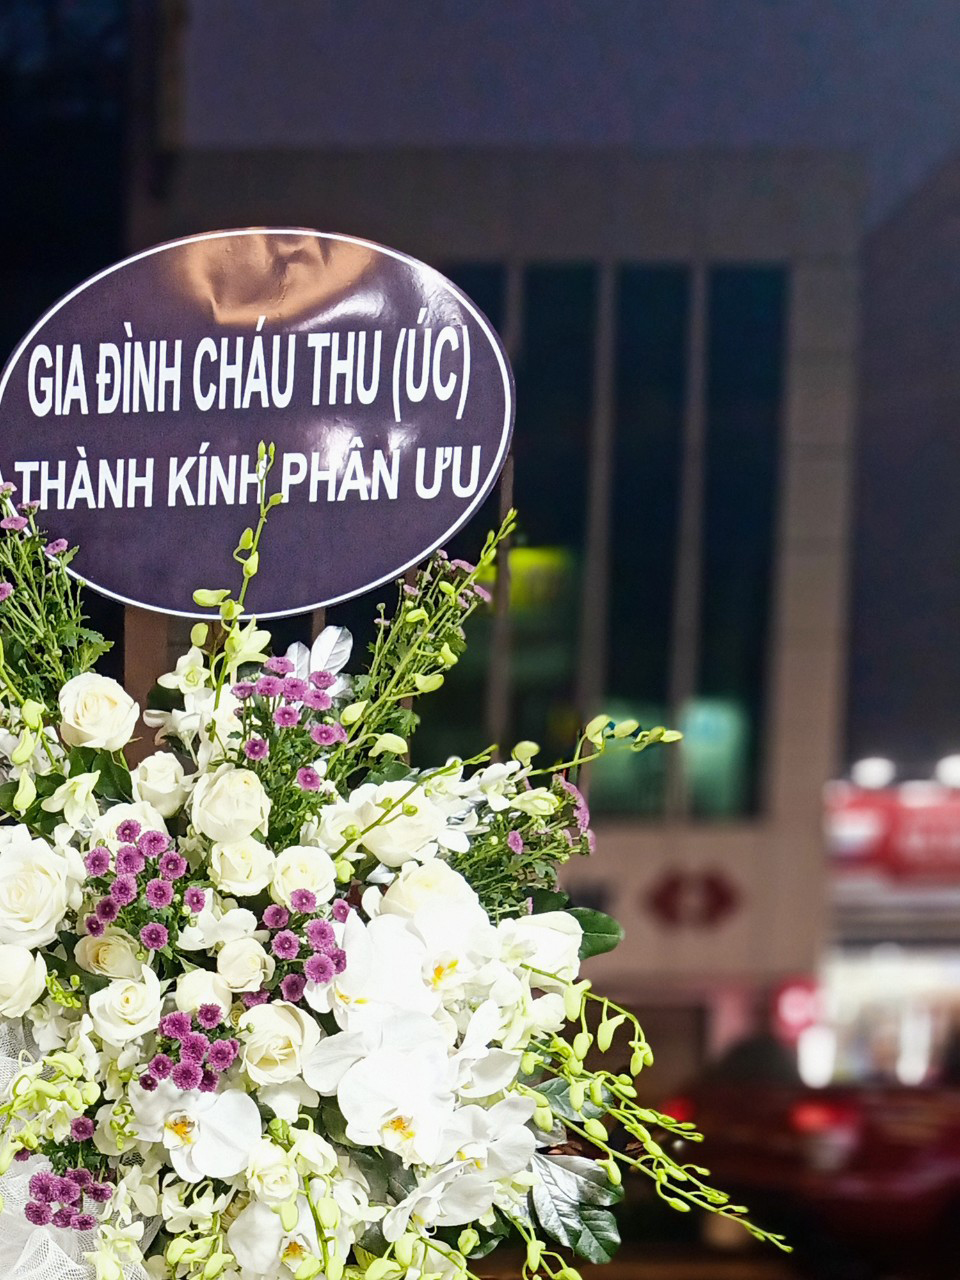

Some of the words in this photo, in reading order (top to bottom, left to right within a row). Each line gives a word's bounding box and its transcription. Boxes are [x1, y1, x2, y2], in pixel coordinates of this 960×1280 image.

[27, 343, 89, 417] GIA
[95, 321, 183, 414] ĐÌNH
[193, 315, 296, 411] CHÁU
[307, 330, 382, 405] THU
[392, 307, 471, 422] (ÚC)
[14, 446, 154, 510] THÀNH
[167, 442, 267, 507] KÍNH
[281, 436, 401, 503] PHÂN
[415, 445, 481, 500] ƯU
